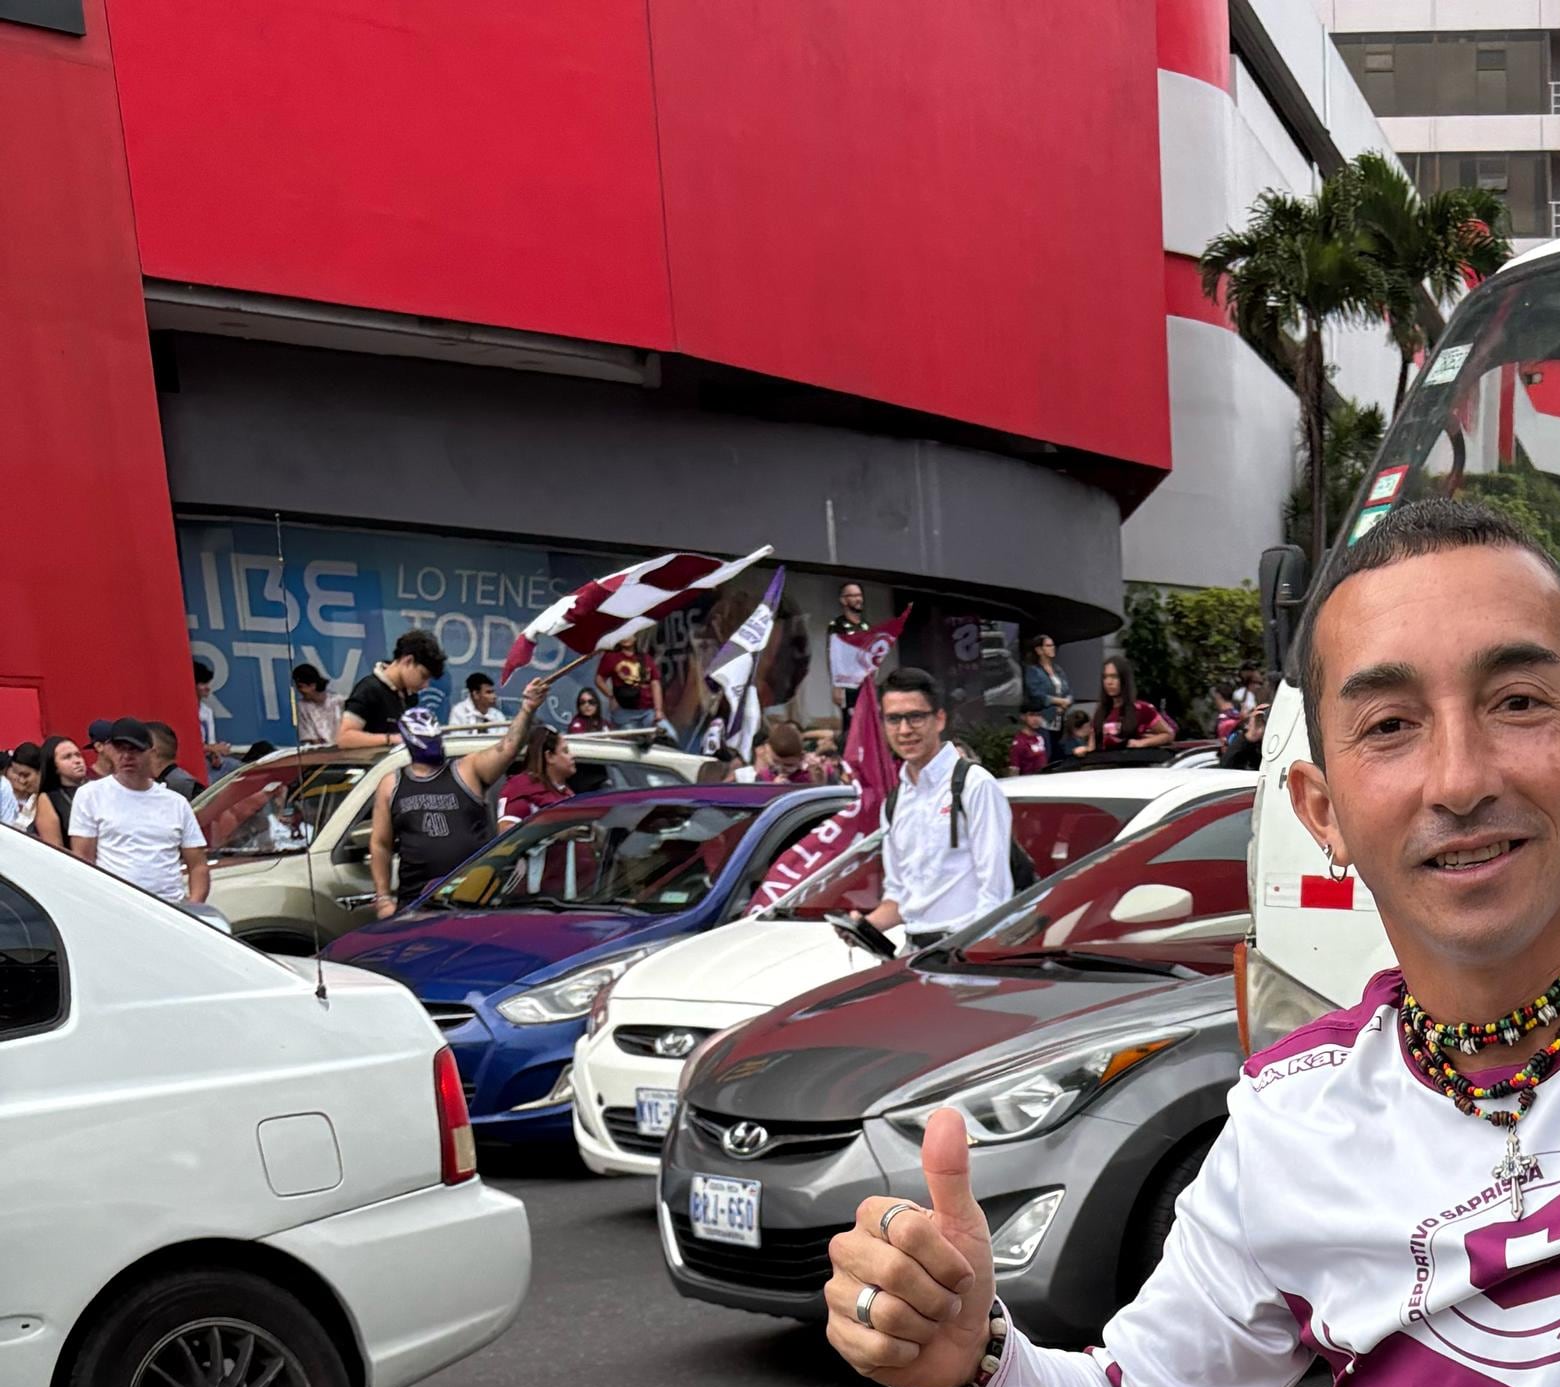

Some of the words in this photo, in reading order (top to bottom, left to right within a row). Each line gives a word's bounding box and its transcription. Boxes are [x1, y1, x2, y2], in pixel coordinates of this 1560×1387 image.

[187, 551, 366, 638] IBE
[396, 564, 446, 602] LO
[1408, 1217, 1440, 1321] DEPORTIVO
